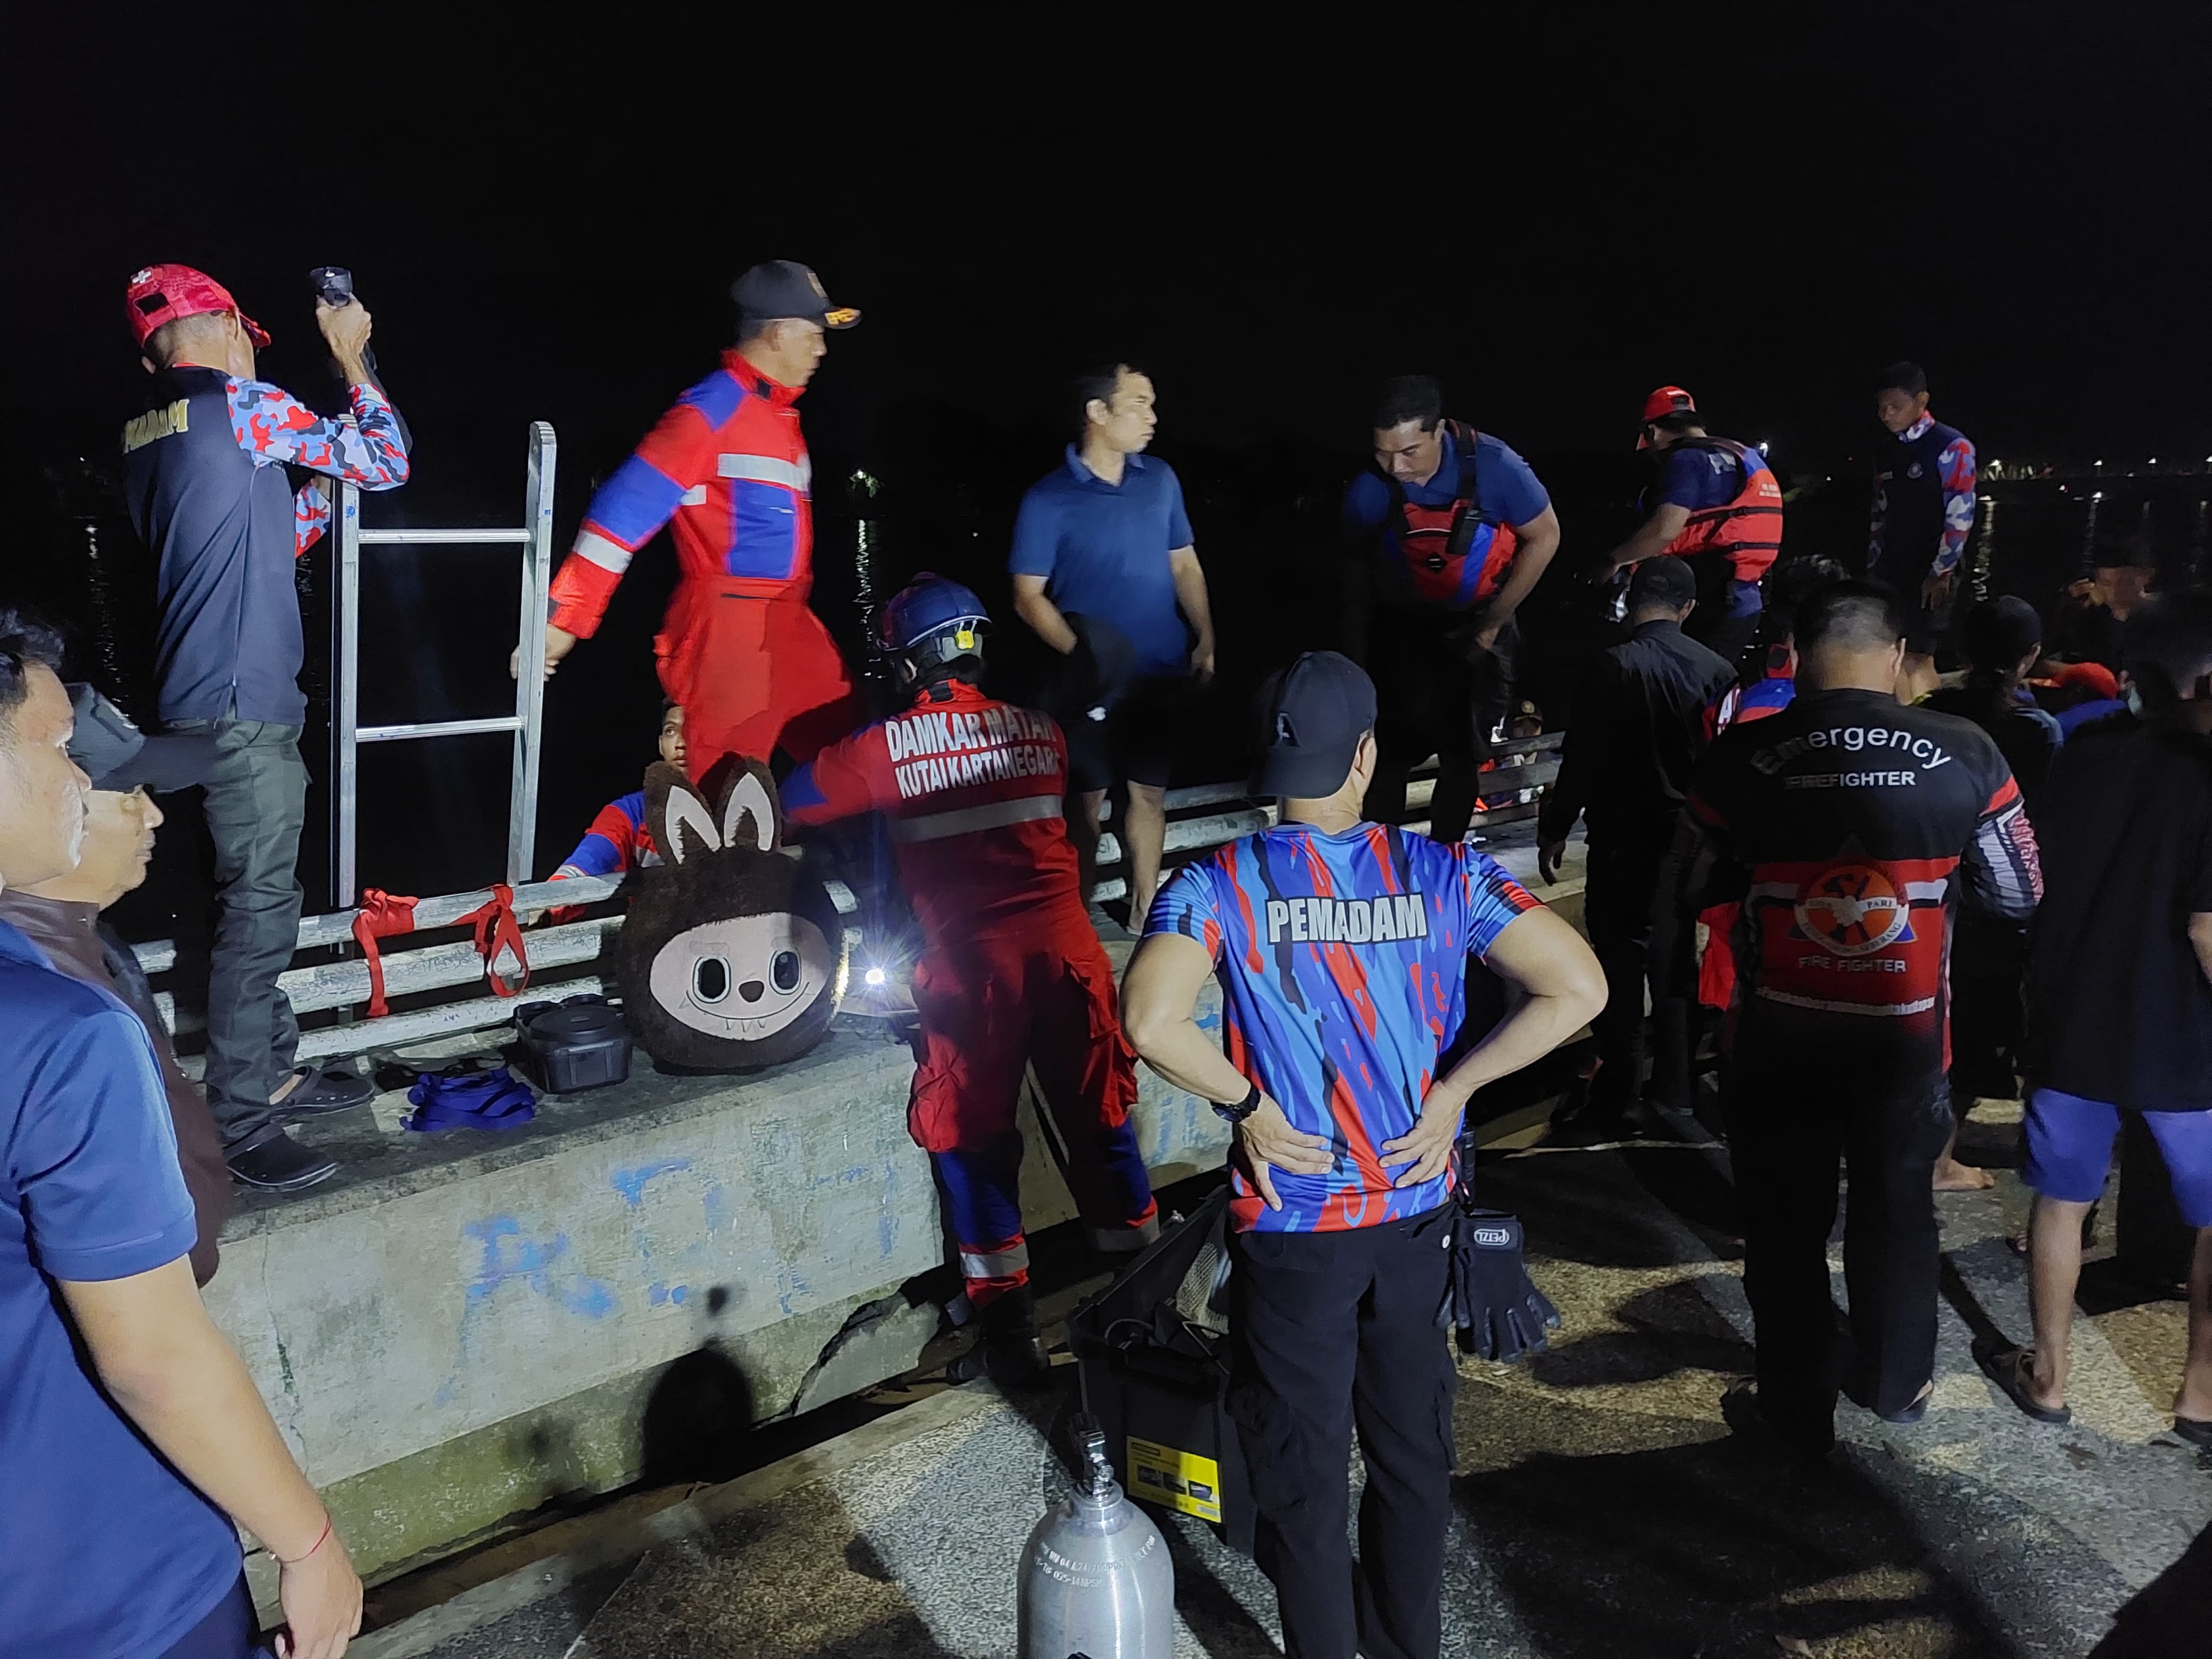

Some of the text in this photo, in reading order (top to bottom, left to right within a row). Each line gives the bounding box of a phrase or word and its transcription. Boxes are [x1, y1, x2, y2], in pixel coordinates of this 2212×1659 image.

[885, 711, 988, 763] DAMKAR
[895, 757, 949, 799] KUTAI
[1266, 893, 1428, 944] PEMADAM
[1798, 955, 1906, 973] FIRE FIGHTER
[1475, 1228, 1507, 1244] PETZL
